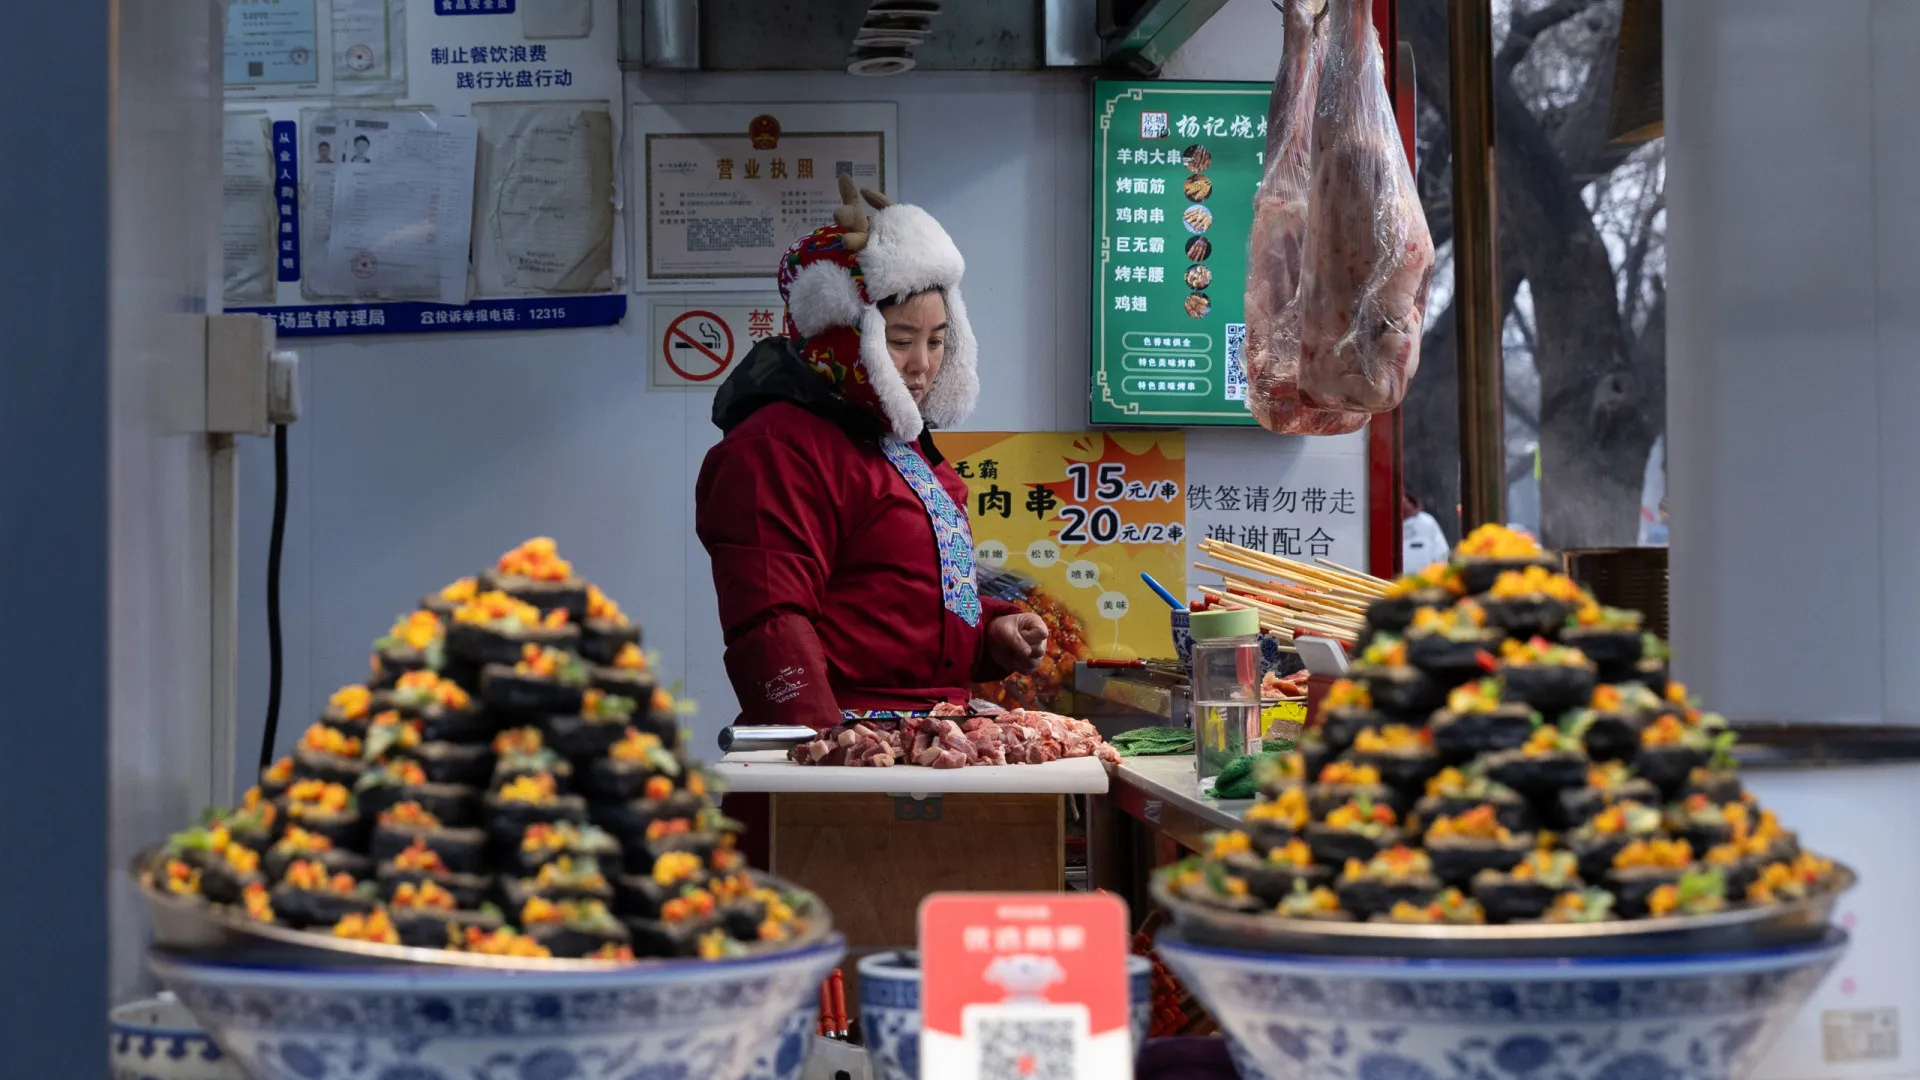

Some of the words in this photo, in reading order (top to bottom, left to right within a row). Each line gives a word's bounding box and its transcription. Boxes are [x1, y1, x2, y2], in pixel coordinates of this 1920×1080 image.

[430, 45, 547, 65] 制止餐饮浪费
[456, 69, 573, 89] 践行光盘行动
[1116, 148, 1182, 165] 羊肉大串
[716, 158, 815, 180] 营业执照
[1116, 177, 1165, 195] 烤面筋
[1116, 207, 1165, 224] 鸡肉串
[1116, 236, 1165, 254] 巨无霸
[1115, 266, 1164, 284] 烤羊腰
[1114, 296, 1147, 313] 鸡翅
[1143, 337, 1191, 347] 色香味俱全
[1138, 357, 1196, 368] 特色美味烤串
[1137, 381, 1196, 391] 特色美味烤串
[978, 484, 1057, 521] 肉串
[1186, 484, 1356, 516] 铁签请勿带走
[1206, 524, 1336, 558] 谢谢配合
[978, 547, 1004, 560] 鲜嫩
[1031, 547, 1056, 560] 松软
[1071, 567, 1096, 580] 喷香
[1103, 599, 1128, 612] 美味
